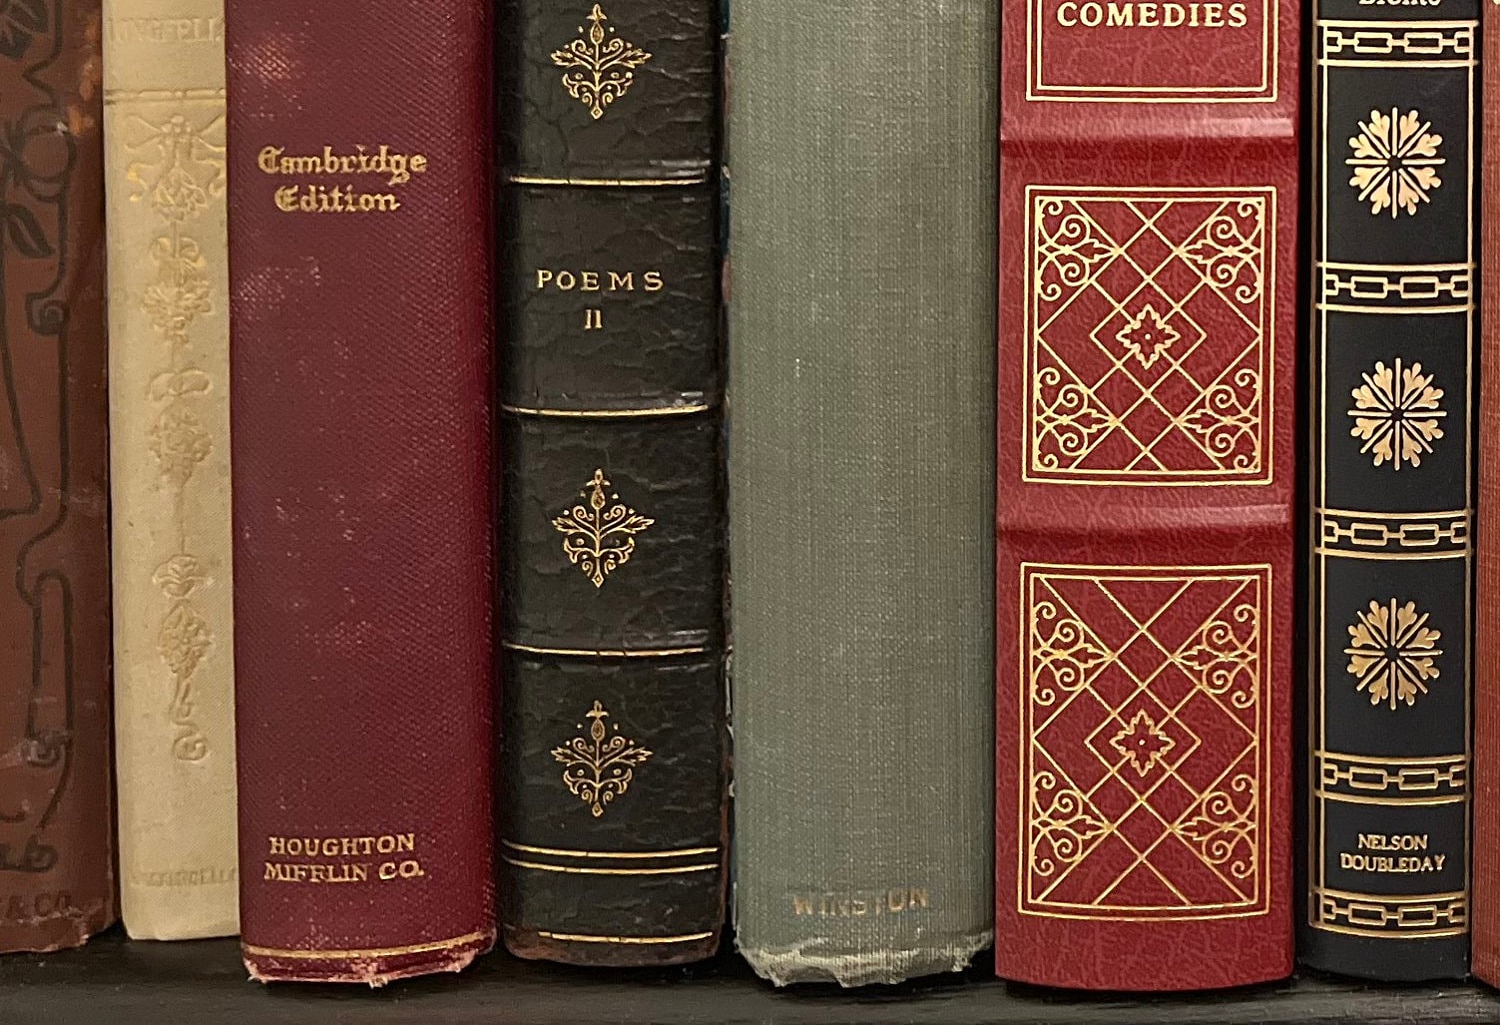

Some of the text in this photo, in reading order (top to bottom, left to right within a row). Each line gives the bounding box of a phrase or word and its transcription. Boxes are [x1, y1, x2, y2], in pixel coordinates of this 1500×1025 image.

[1056, 1, 1248, 28] COMEDIES
[257, 144, 428, 187] Cambridge
[274, 184, 400, 213] Edition
[536, 269, 665, 292] POEMS
[583, 308, 603, 329] II
[269, 833, 415, 857] HOUGHTON
[1357, 832, 1428, 851] NELSON
[263, 861, 369, 883] MIFFLIN
[378, 859, 425, 881] CO.
[1339, 851, 1446, 873] DOUBLEDAY
[790, 887, 929, 919] WINSON
